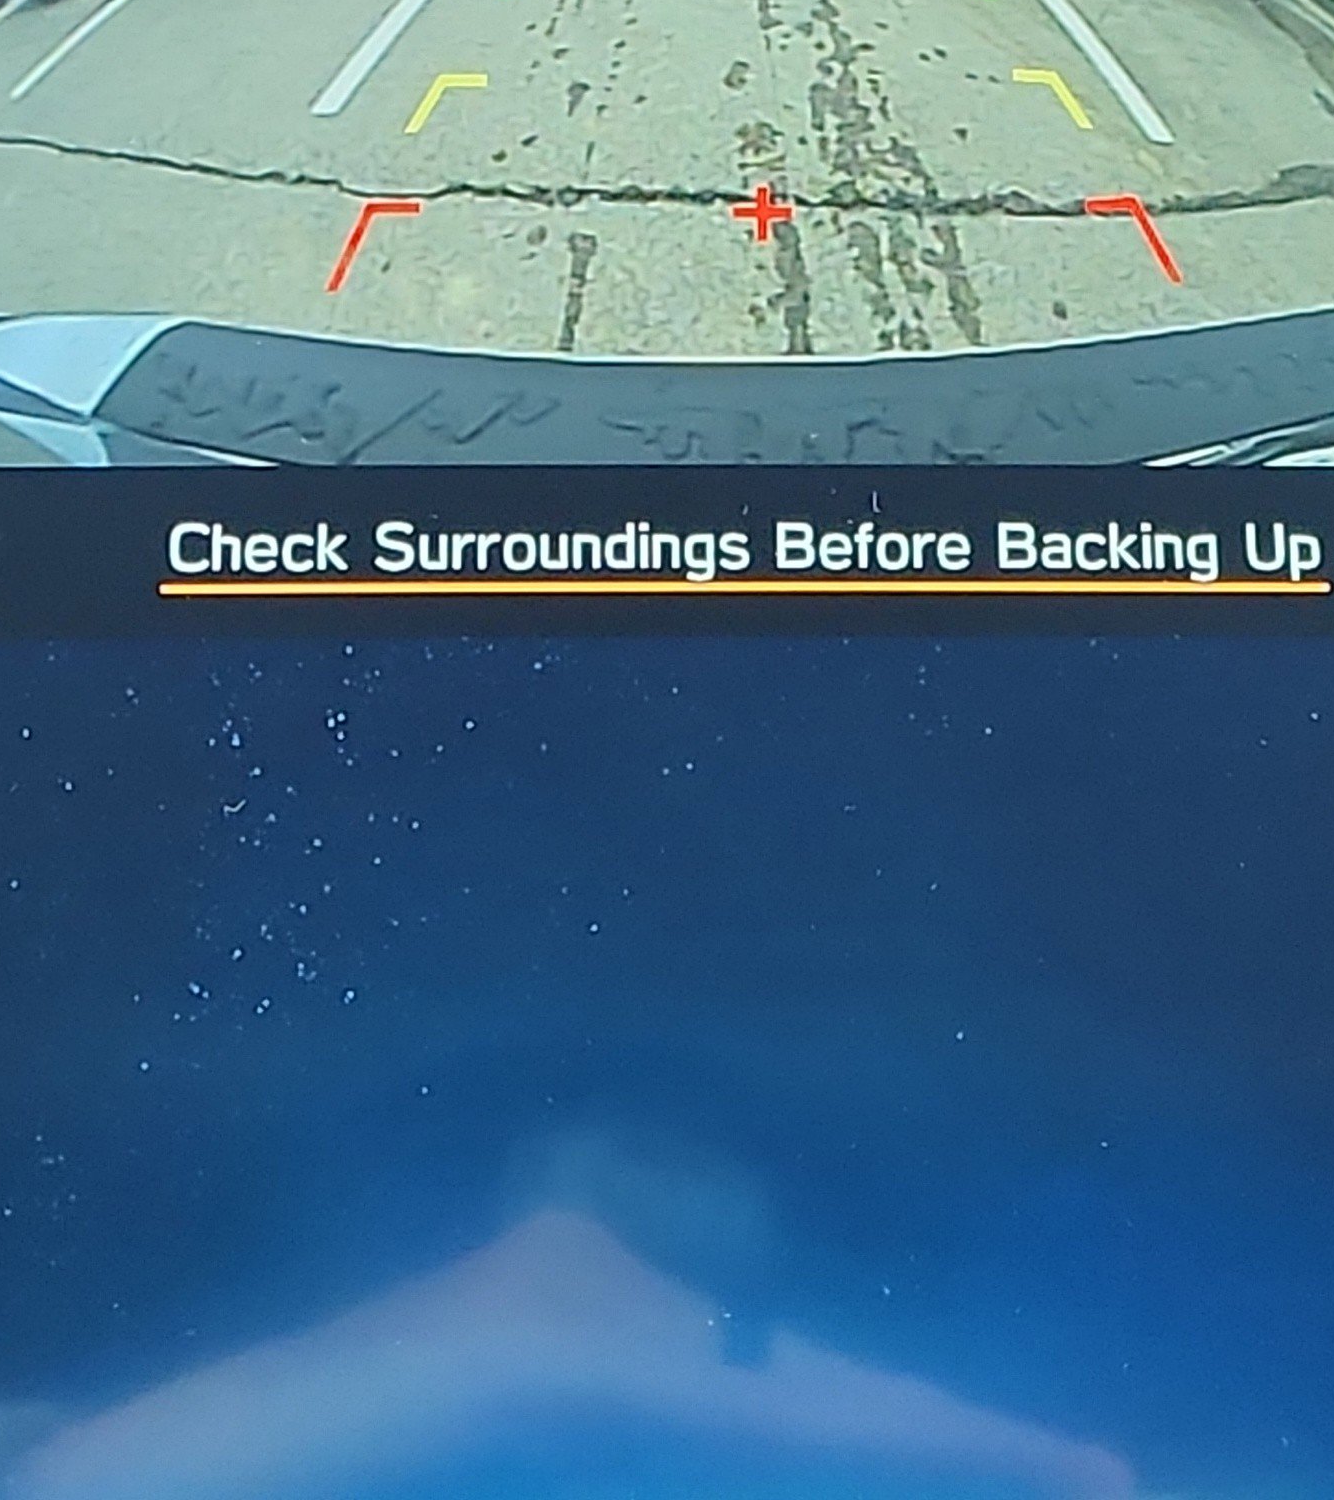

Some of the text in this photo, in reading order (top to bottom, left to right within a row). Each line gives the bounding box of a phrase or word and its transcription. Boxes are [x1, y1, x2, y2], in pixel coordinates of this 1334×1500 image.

[169, 520, 1321, 581] Check Surroundings Before Backing Up
